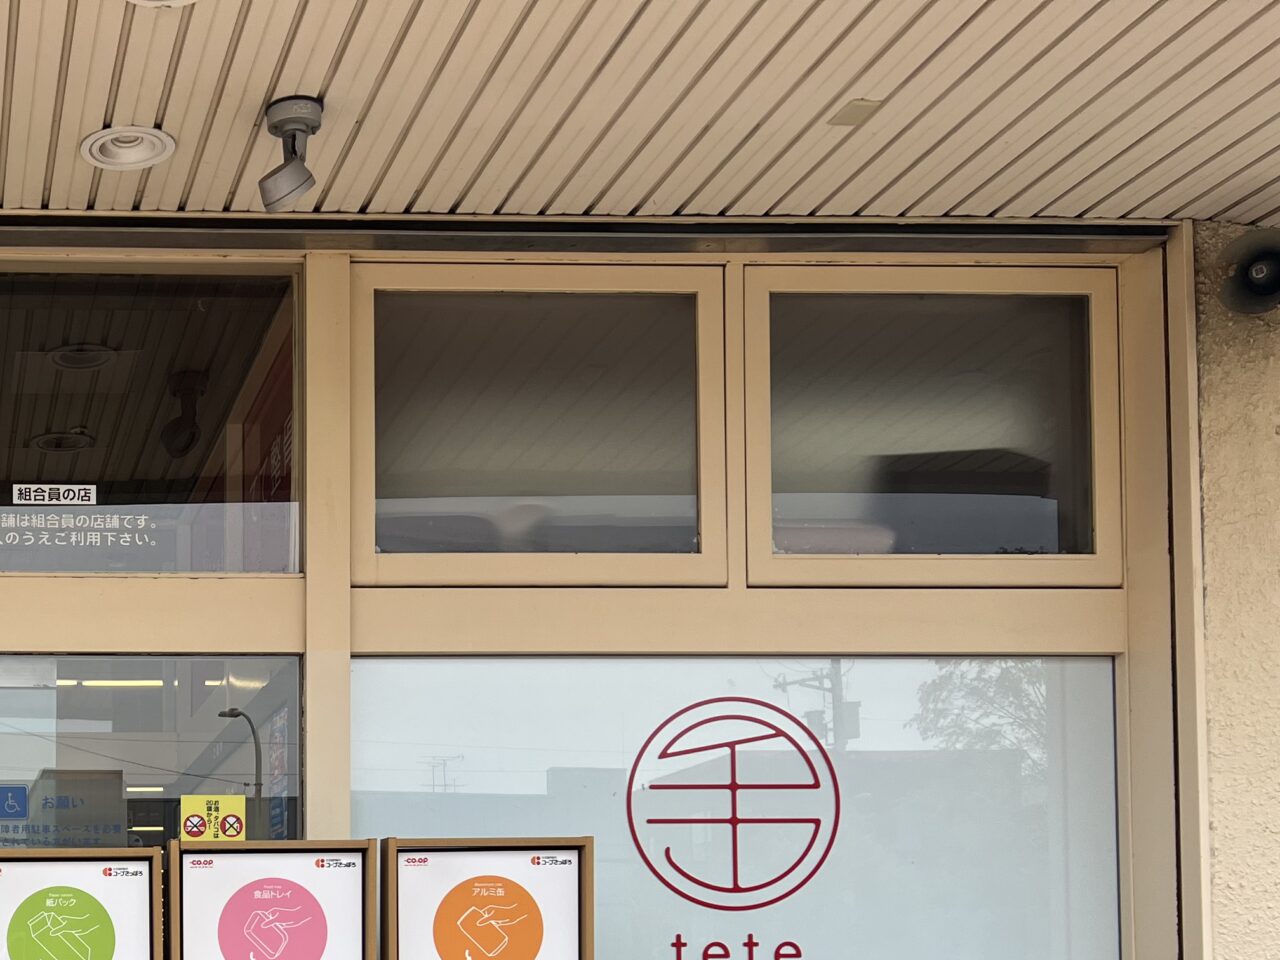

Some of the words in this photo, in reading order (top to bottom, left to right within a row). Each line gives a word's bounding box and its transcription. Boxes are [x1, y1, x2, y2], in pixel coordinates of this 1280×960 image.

[17, 487, 92, 502] 組合員の店
[42, 795, 85, 810] お願い
[253, 890, 292, 899] 食品トレイ
[472, 887, 505, 897] アルミ缶
[45, 898, 77, 907] 紙パック
